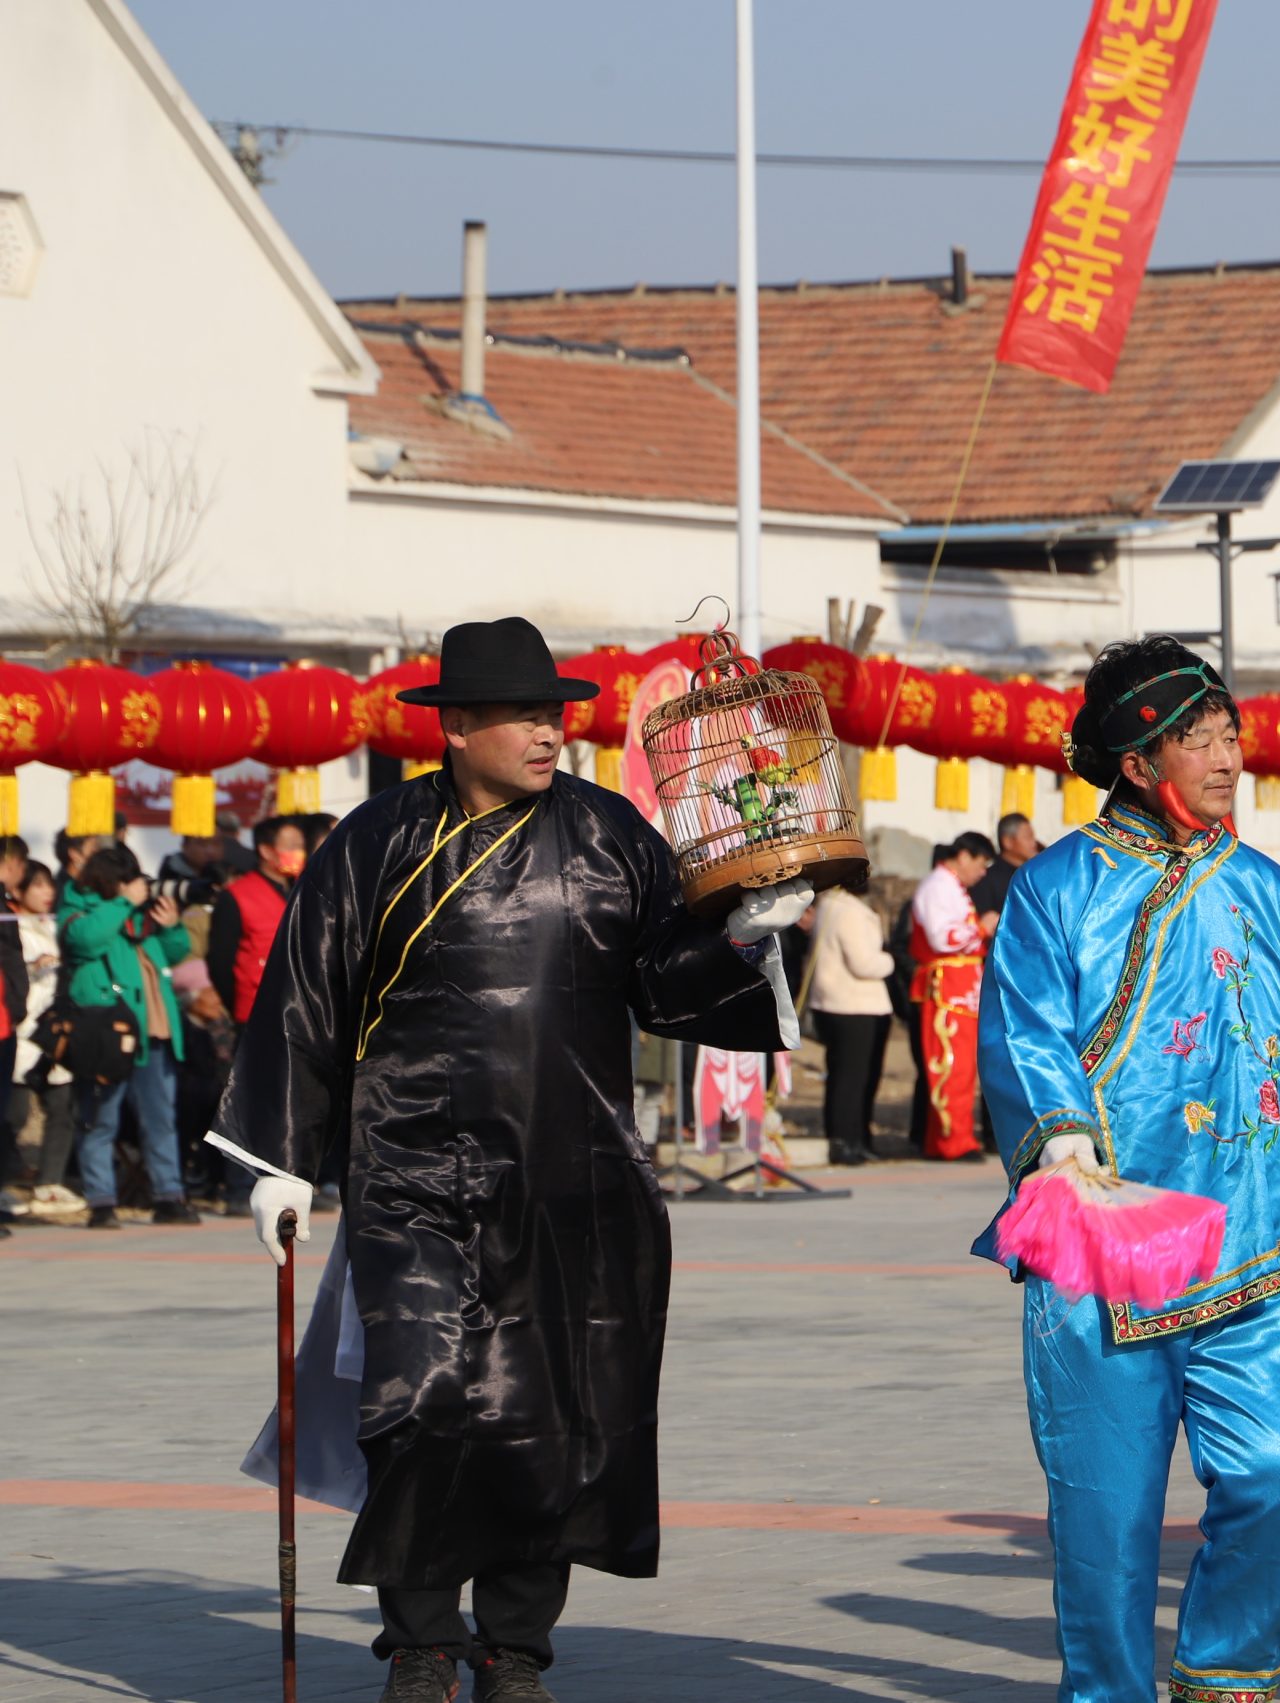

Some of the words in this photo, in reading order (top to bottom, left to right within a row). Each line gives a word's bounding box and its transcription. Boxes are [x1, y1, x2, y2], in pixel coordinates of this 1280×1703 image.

[1024, 0, 1191, 333] 的美好生活
